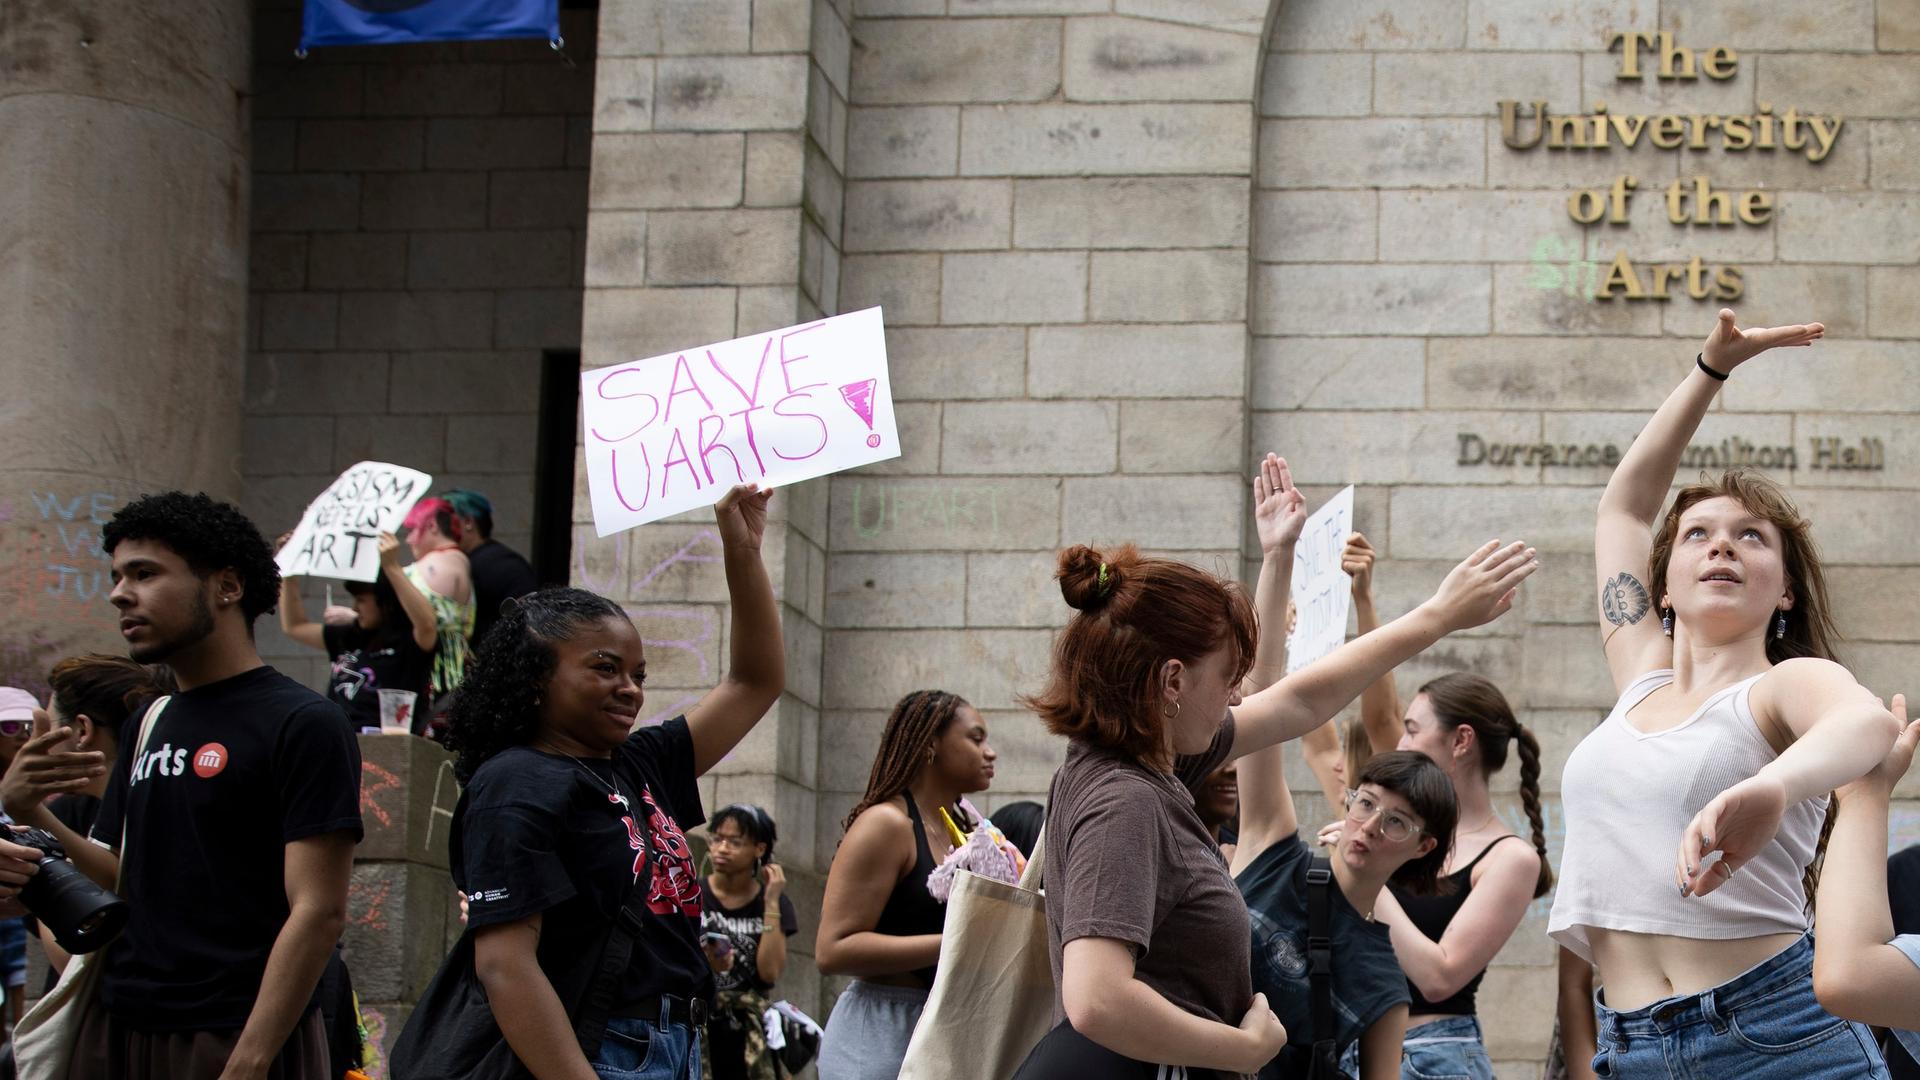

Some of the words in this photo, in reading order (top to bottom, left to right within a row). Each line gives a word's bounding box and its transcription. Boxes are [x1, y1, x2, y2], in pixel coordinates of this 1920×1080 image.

[1607, 30, 1739, 80] The
[1497, 99, 1844, 161] University
[1566, 174, 1638, 225] of
[1664, 174, 1774, 226] the
[1599, 250, 1746, 303] Arts
[592, 323, 828, 442] SAVE
[1456, 433, 1619, 468] Dorrance
[1809, 437, 1886, 470] Hall
[32, 490, 116, 526] WE
[289, 530, 378, 570] ART
